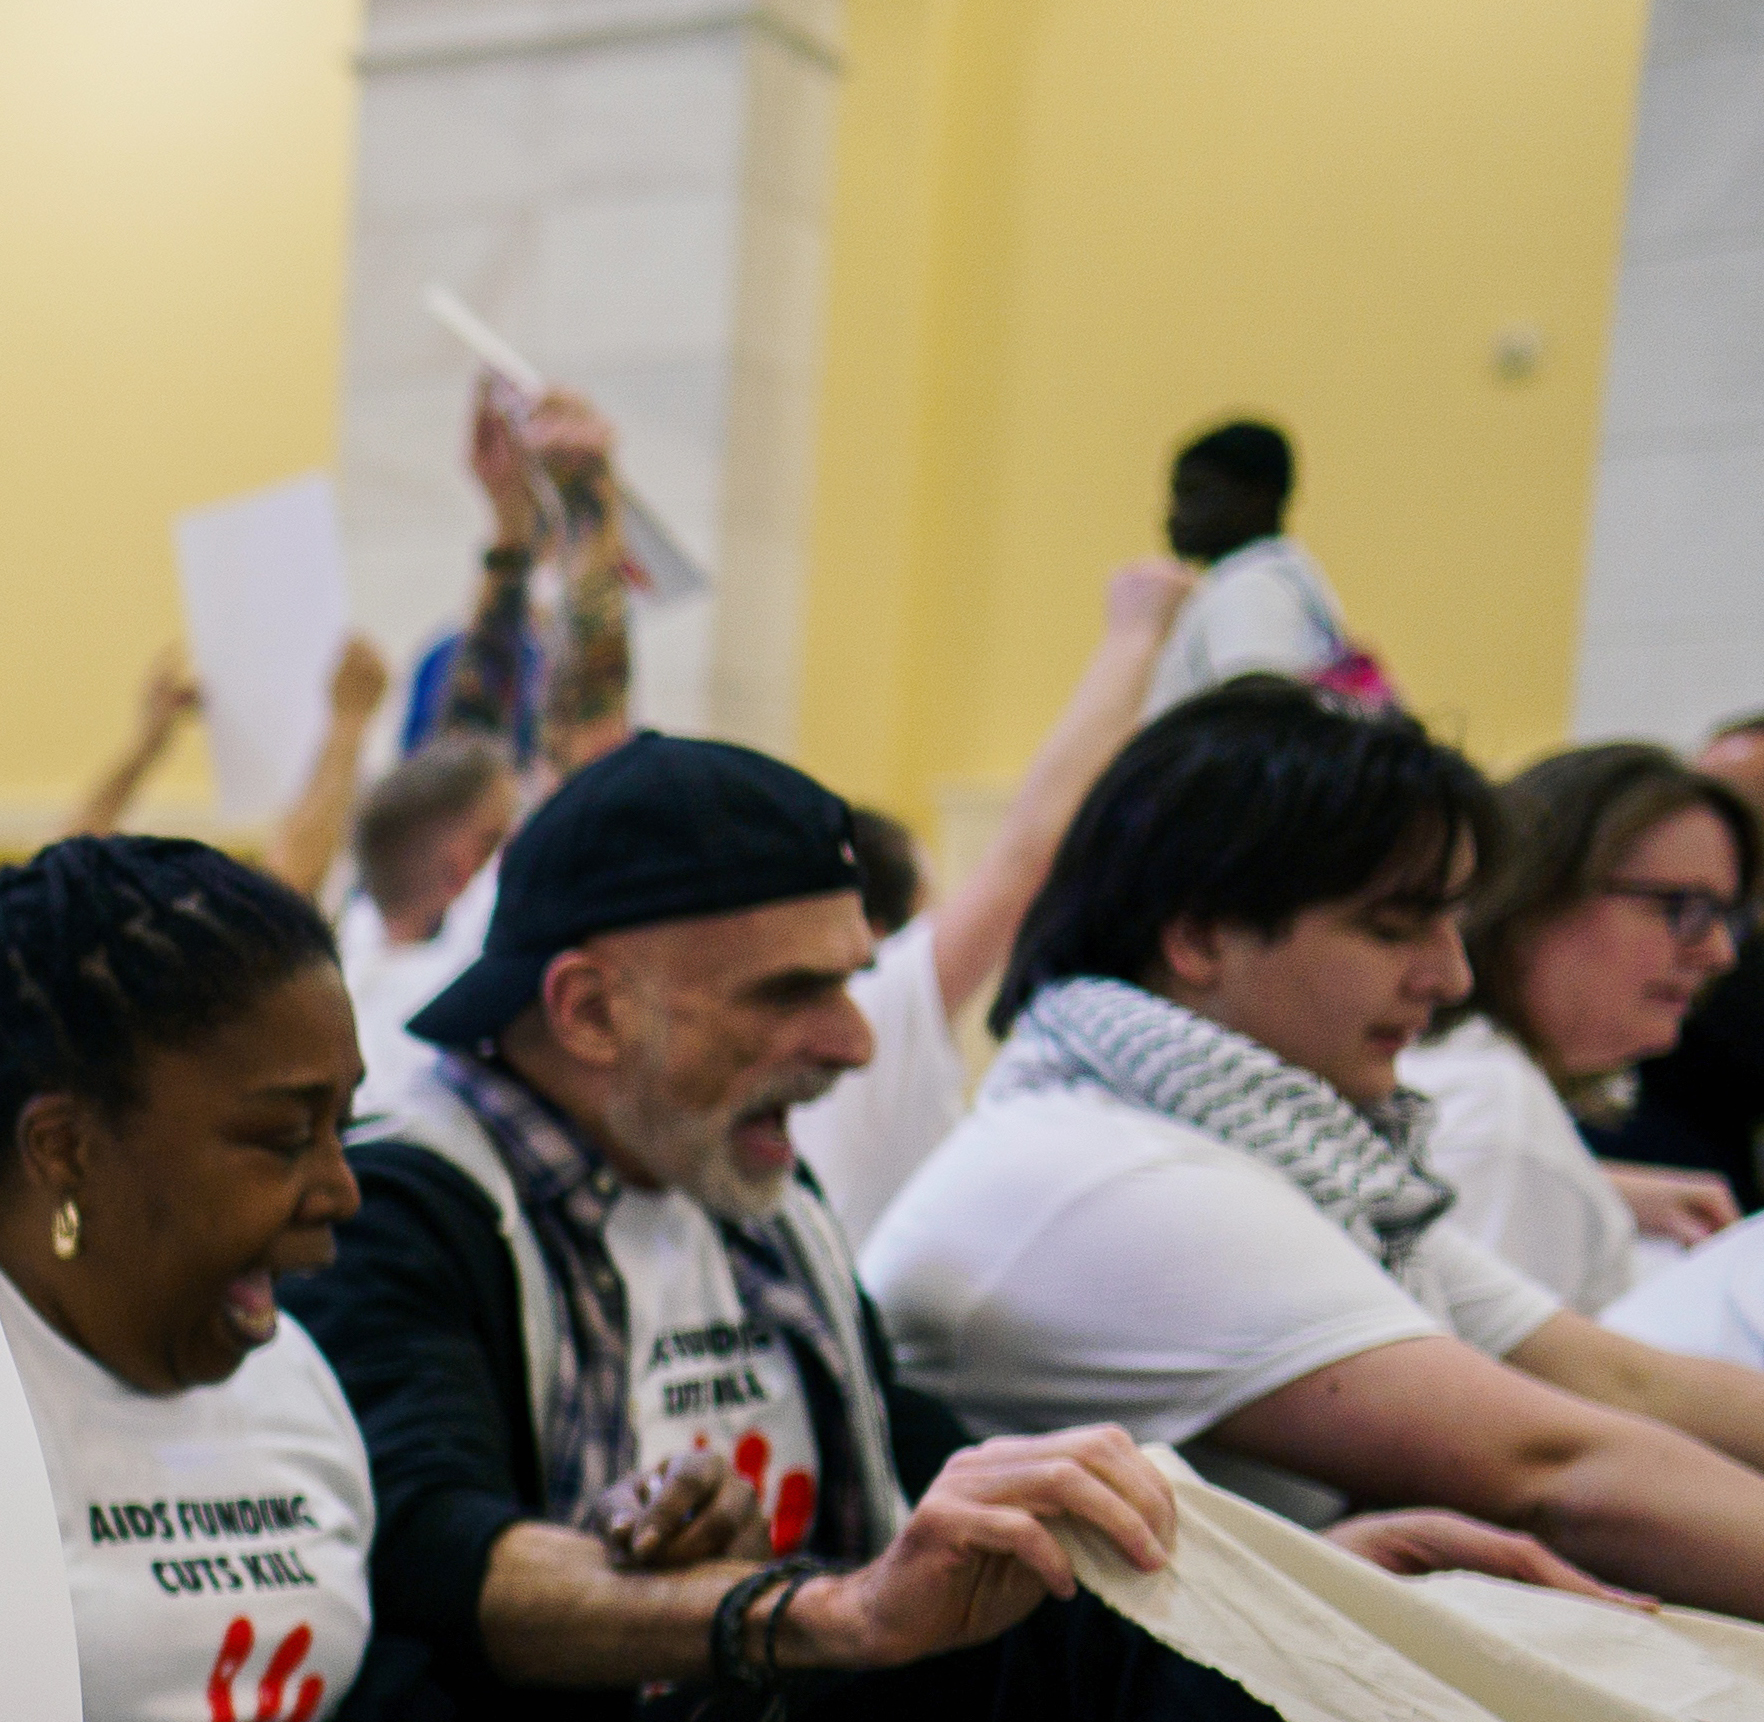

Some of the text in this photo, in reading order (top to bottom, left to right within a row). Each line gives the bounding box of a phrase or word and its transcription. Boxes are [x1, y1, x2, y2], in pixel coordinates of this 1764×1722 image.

[89, 1495, 321, 1544] AIDS FUNDING
[152, 1549, 316, 1594] CUTS KILL
